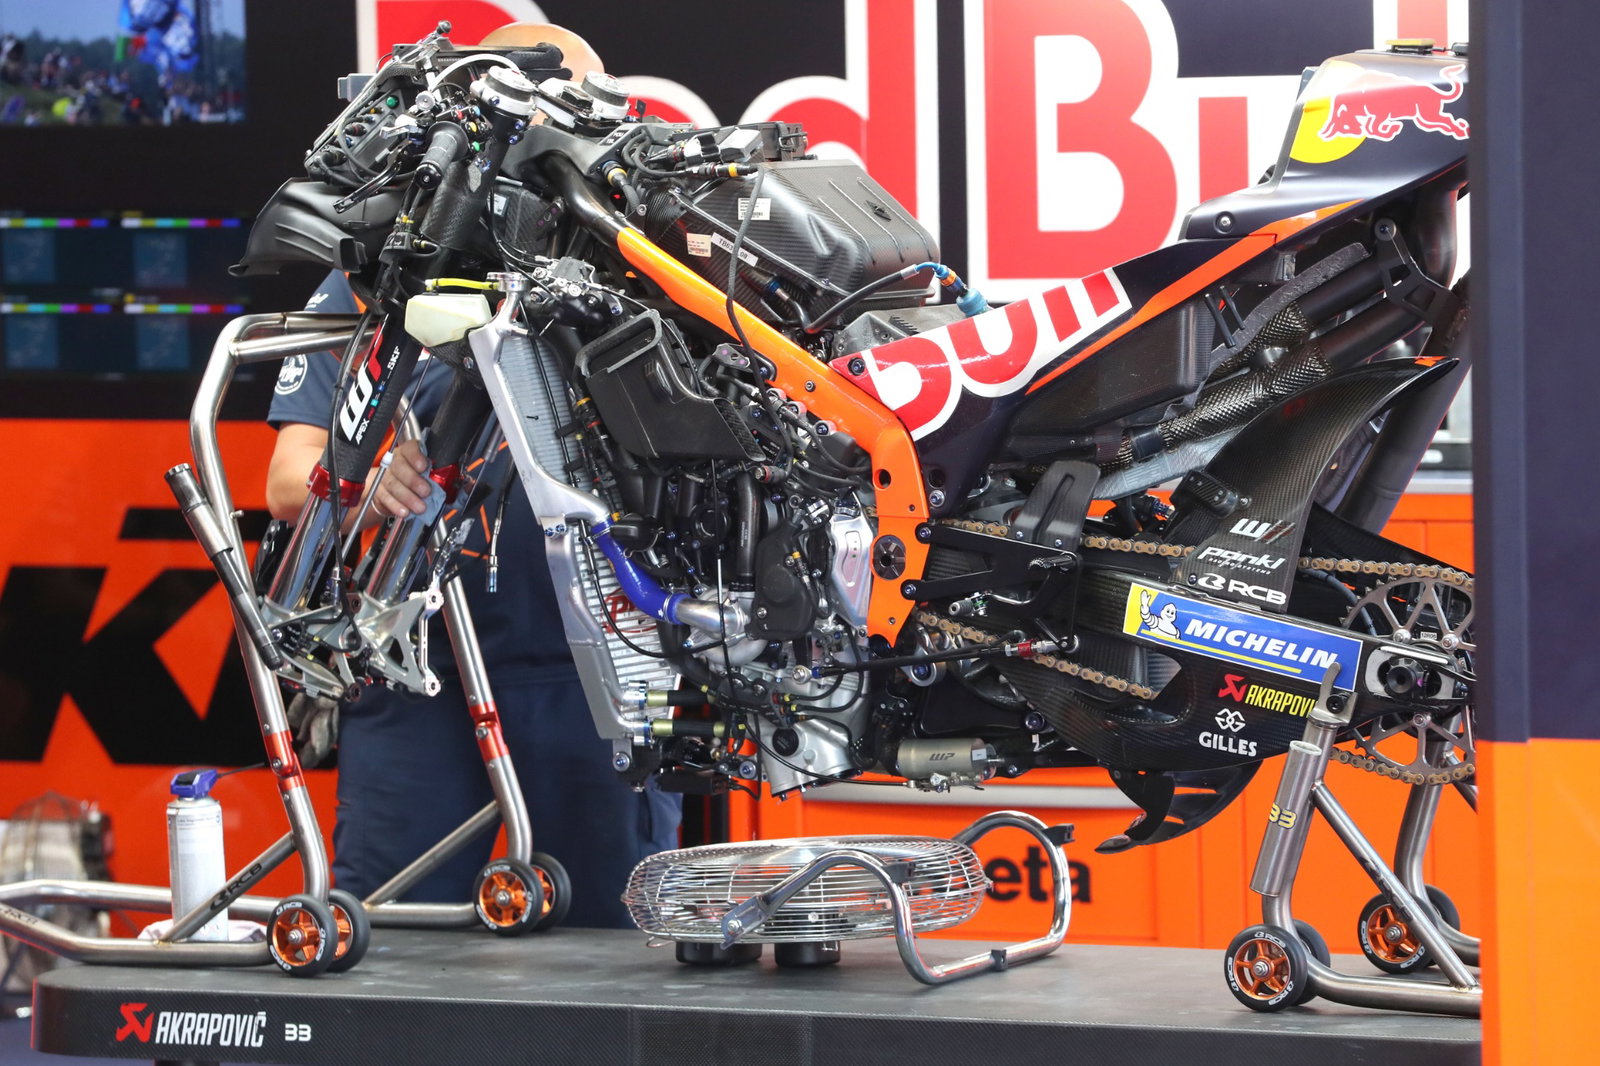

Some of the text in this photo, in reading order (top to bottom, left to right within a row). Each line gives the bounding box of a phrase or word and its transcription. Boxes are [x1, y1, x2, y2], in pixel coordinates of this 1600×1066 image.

[355, 418, 371, 445] APEX
[387, 346, 400, 370] SKF
[1228, 579, 1287, 605] RCB
[1184, 618, 1338, 669] MICHELIN
[1245, 684, 1319, 719] AKRAPOVI
[1198, 731, 1258, 757] GILLES
[1268, 802, 1298, 829] 33
[983, 845, 1092, 904] eta
[155, 1011, 312, 1048] AKRAPOVIČ 33
